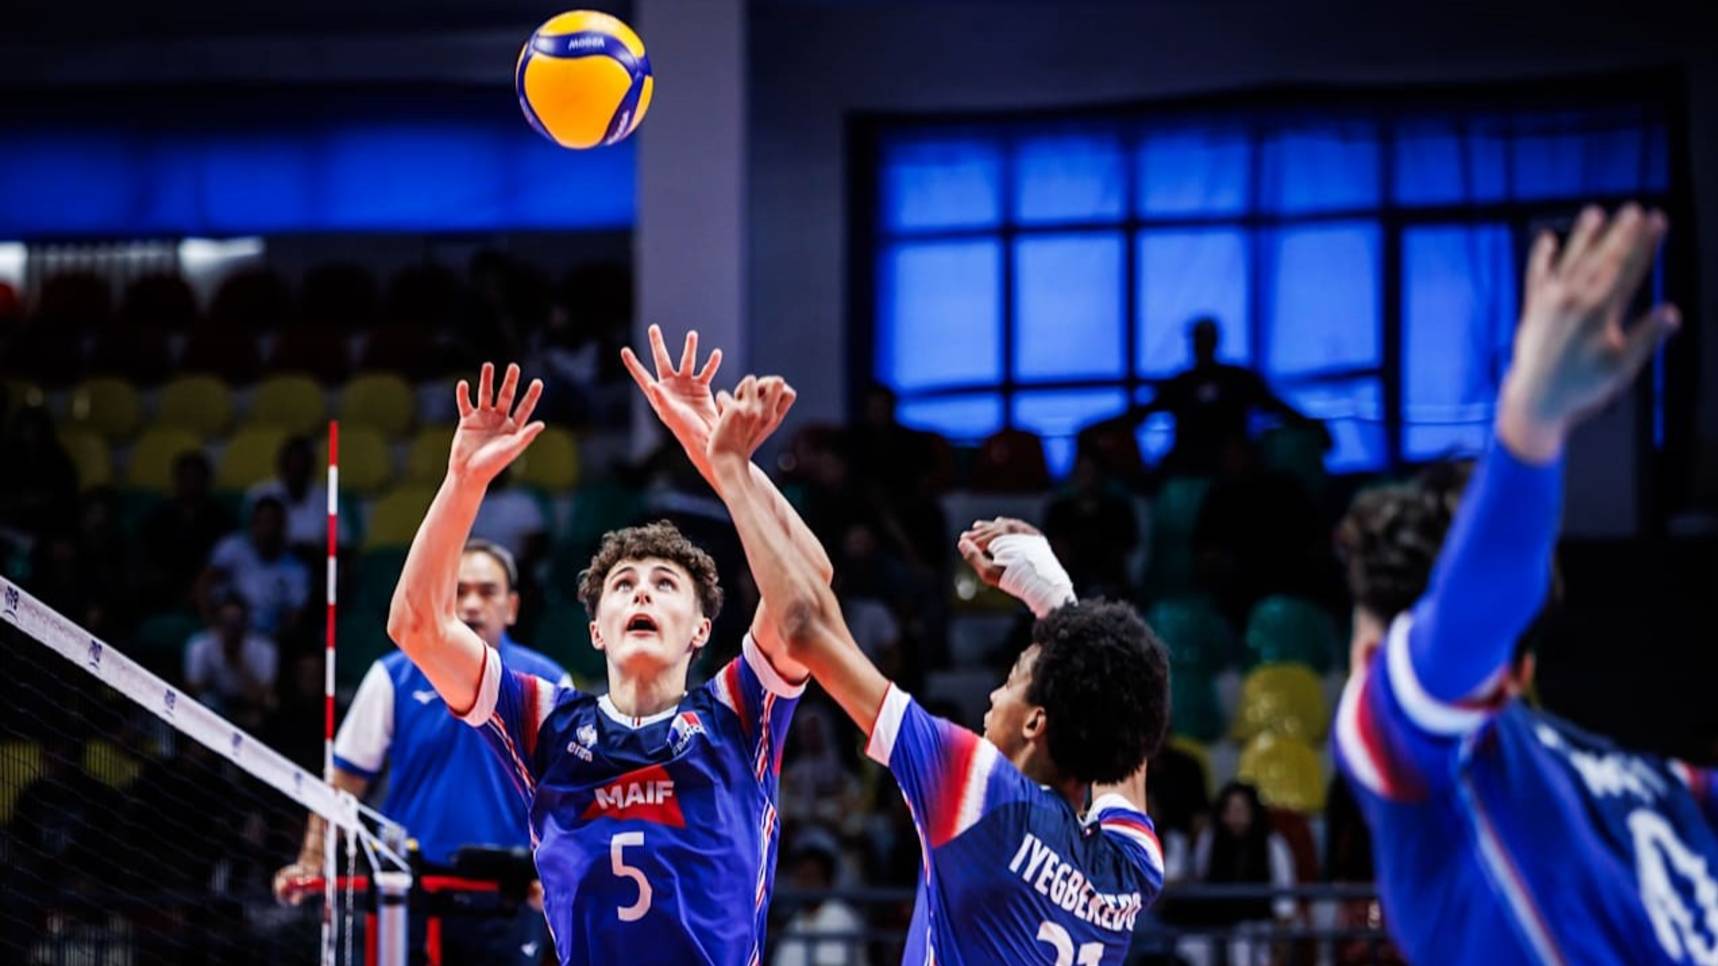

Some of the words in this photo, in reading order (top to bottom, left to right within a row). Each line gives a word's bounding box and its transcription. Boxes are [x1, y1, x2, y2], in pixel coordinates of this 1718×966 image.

[594, 780, 674, 810] MAIF
[610, 831, 652, 922] 5
[1008, 832, 1142, 932] IYEGBEKEDO
